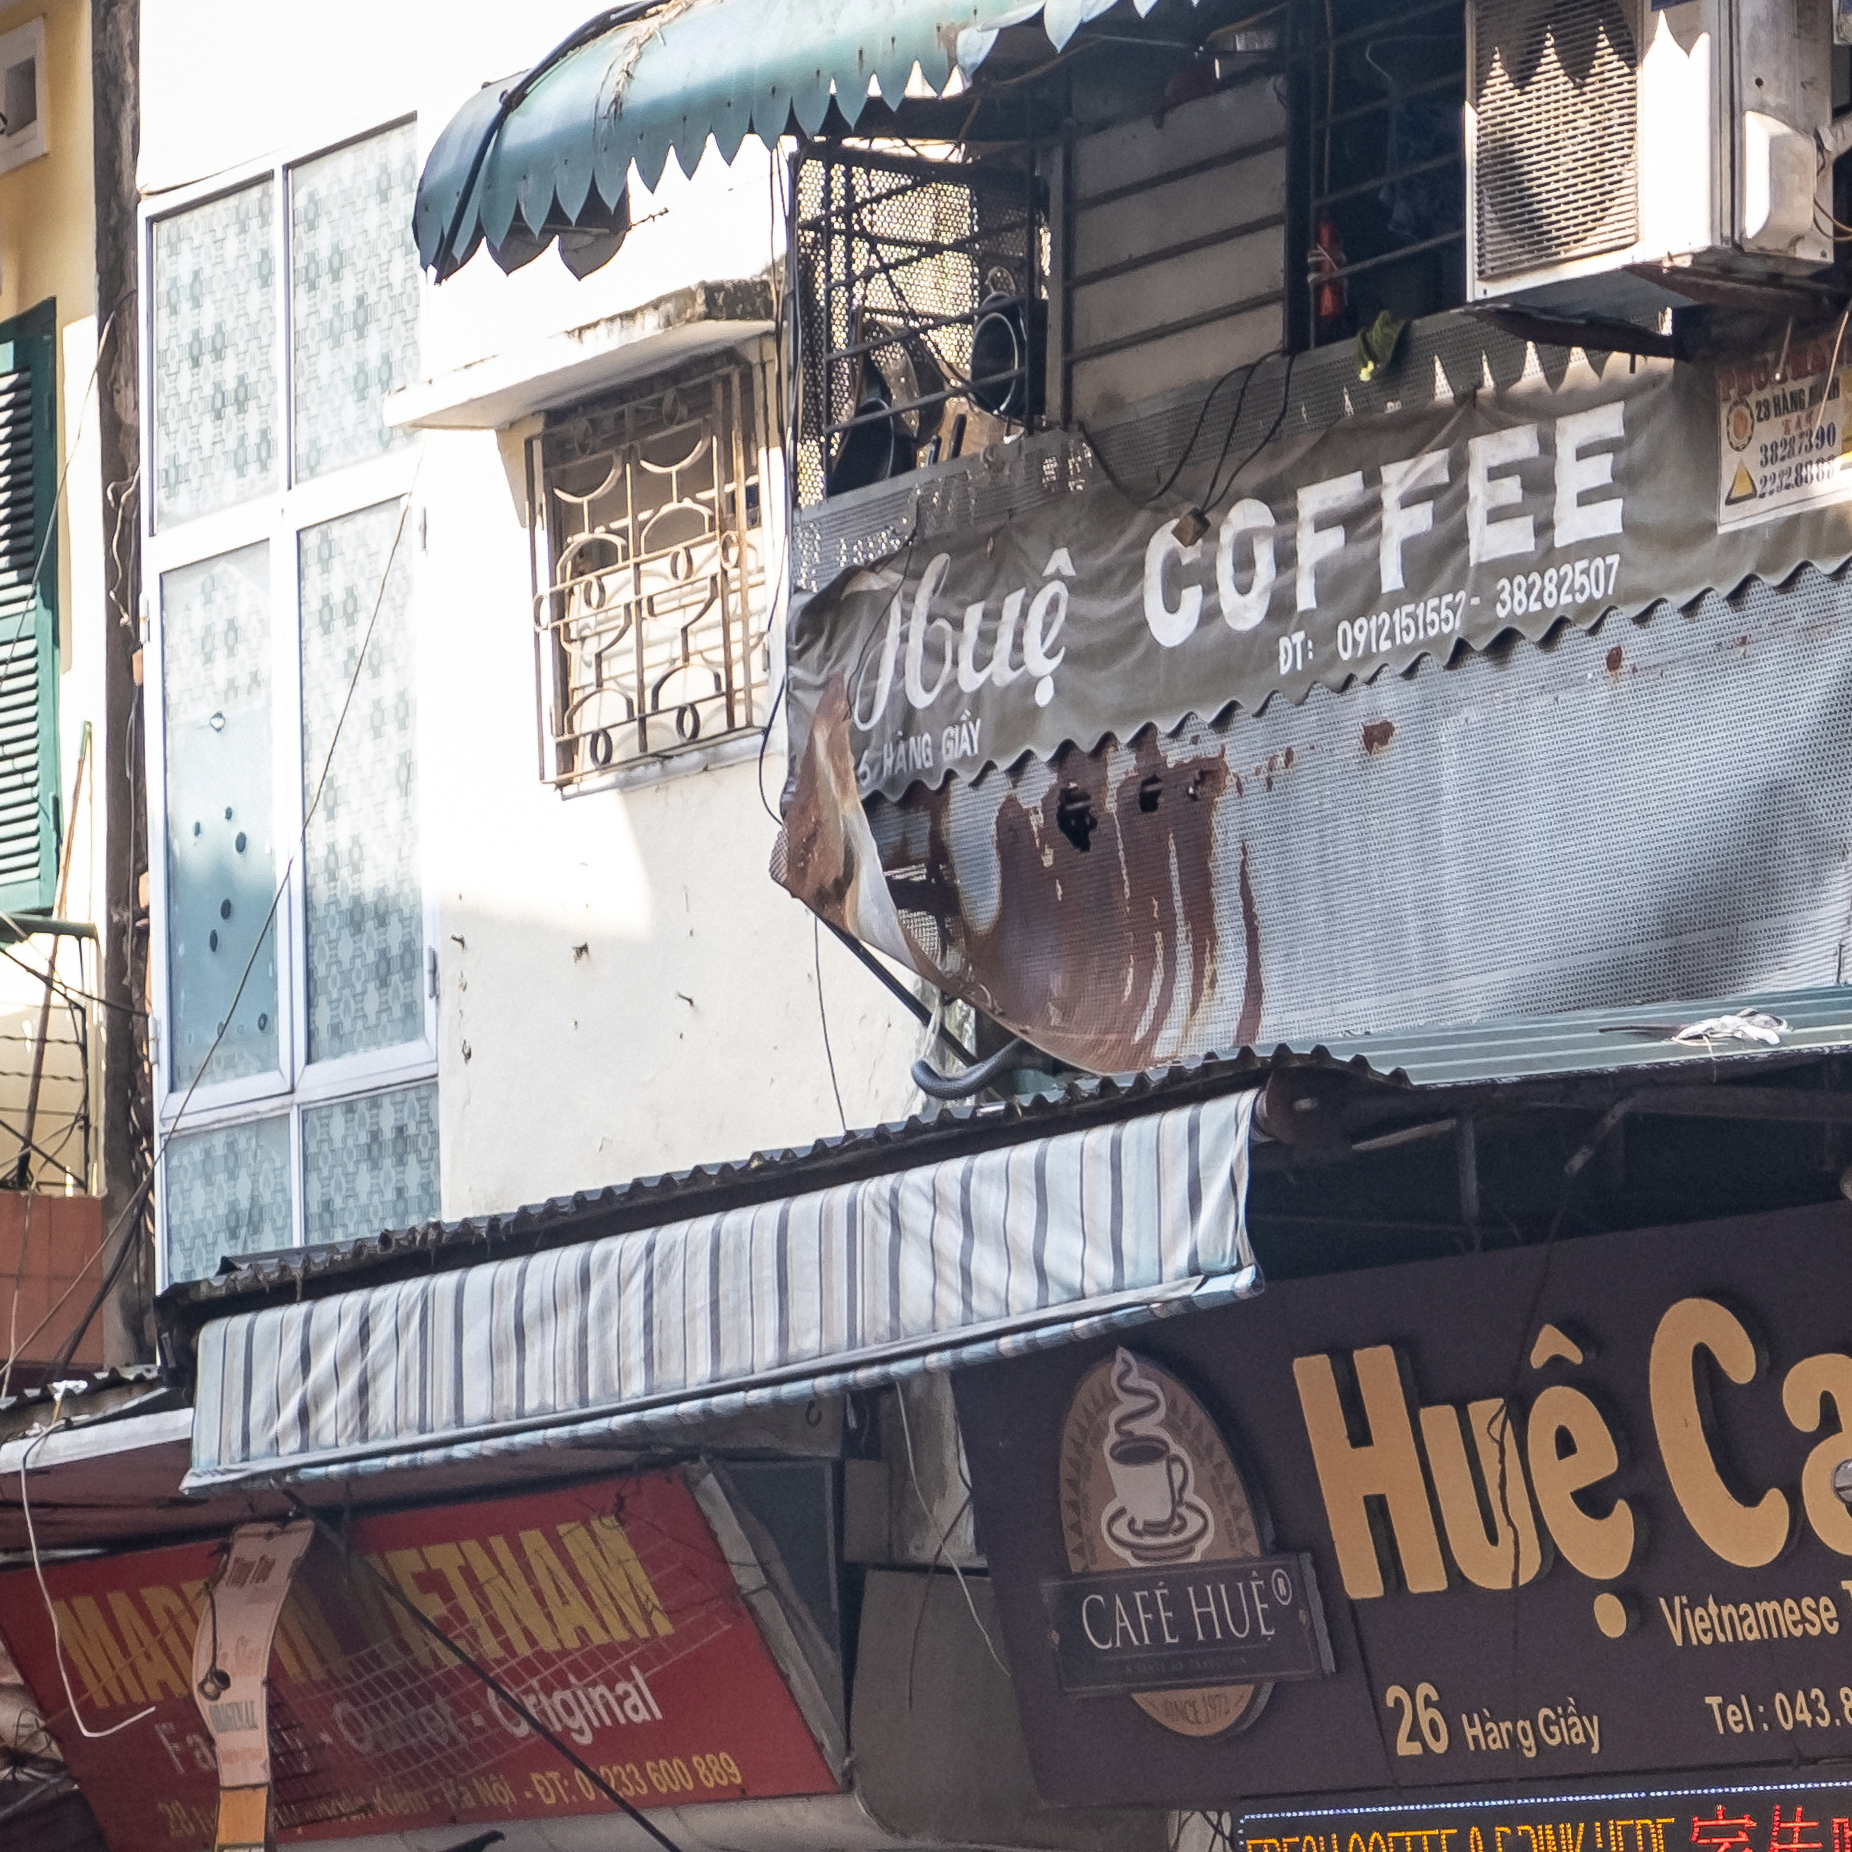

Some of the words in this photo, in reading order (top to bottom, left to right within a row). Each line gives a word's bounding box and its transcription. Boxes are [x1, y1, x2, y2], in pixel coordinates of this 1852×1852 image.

[1774, 386, 1806, 418] HÀNG
[853, 545, 1076, 731] Huệ
[1143, 400, 1627, 648] COFFEE
[1278, 631, 1313, 675] ĐT:
[1495, 554, 1621, 618] 38282507
[883, 730, 933, 779] HÀNG
[1293, 1323, 1636, 1638] Huệ
[56, 1580, 206, 1708] MAD
[362, 1514, 674, 1675] IETNAM
[1081, 1581, 1181, 1650] CAFÉ
[1659, 1591, 1840, 1648] Vietnamese
[489, 1663, 663, 1743] Original
[1385, 1684, 1449, 1758] 26
[1460, 1700, 1538, 1759] Hàng
[1540, 1696, 1601, 1756] Giầy
[574, 1762, 646, 1803] 0233
[647, 1756, 692, 1796] 600
